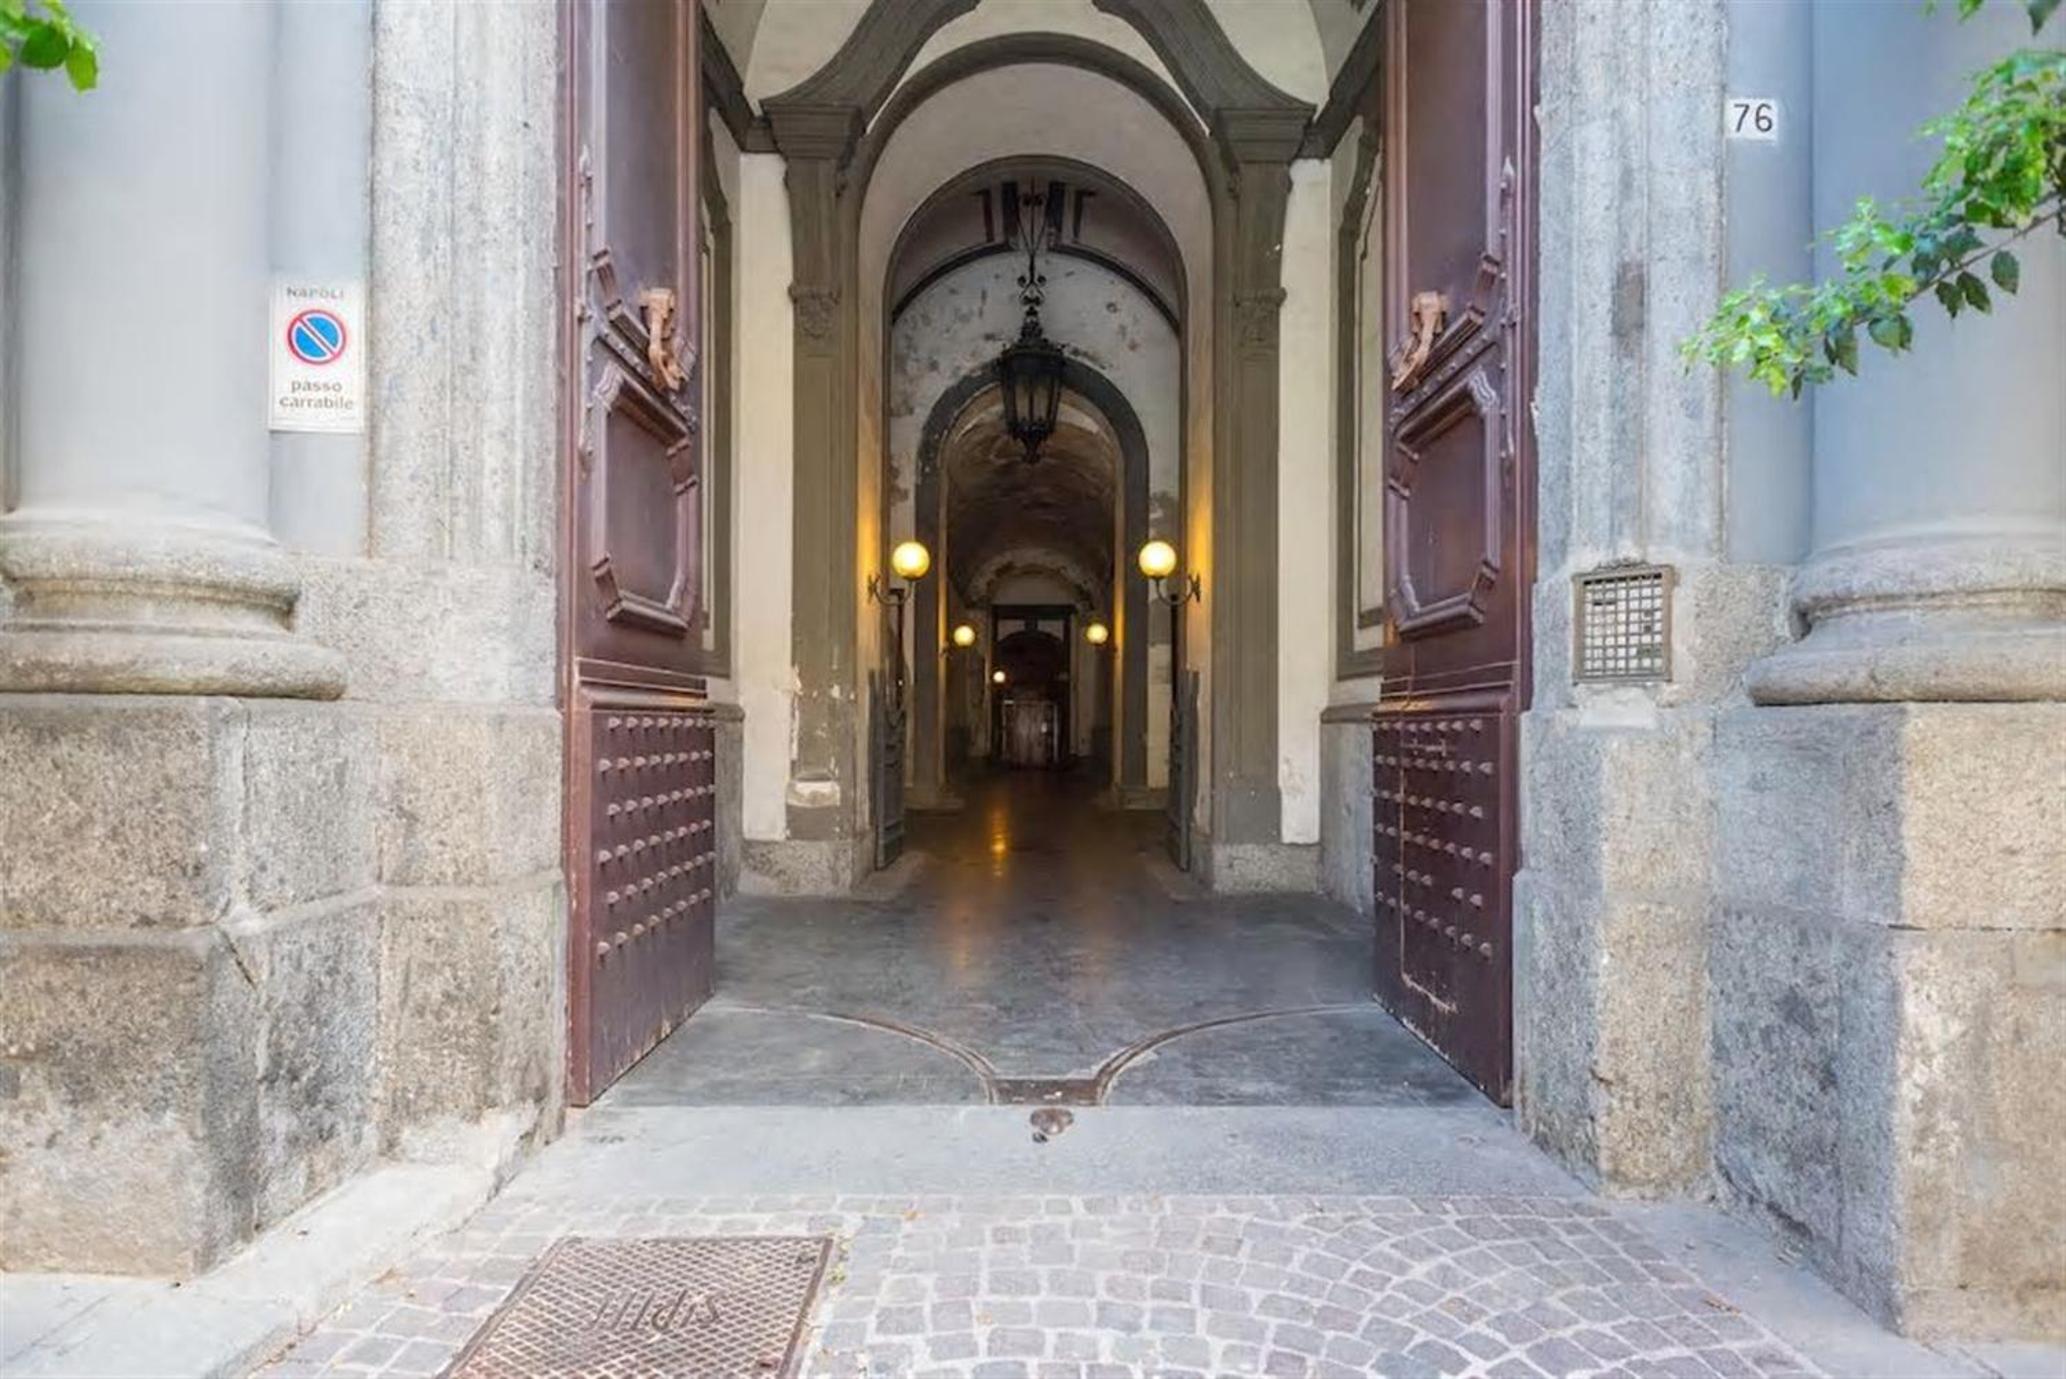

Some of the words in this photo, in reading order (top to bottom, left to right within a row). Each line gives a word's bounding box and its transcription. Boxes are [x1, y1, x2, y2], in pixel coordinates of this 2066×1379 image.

[1733, 103, 1773, 133] 76
[286, 287, 345, 299] NAPOLI
[291, 380, 343, 393] passo
[279, 395, 354, 410] carrabile
